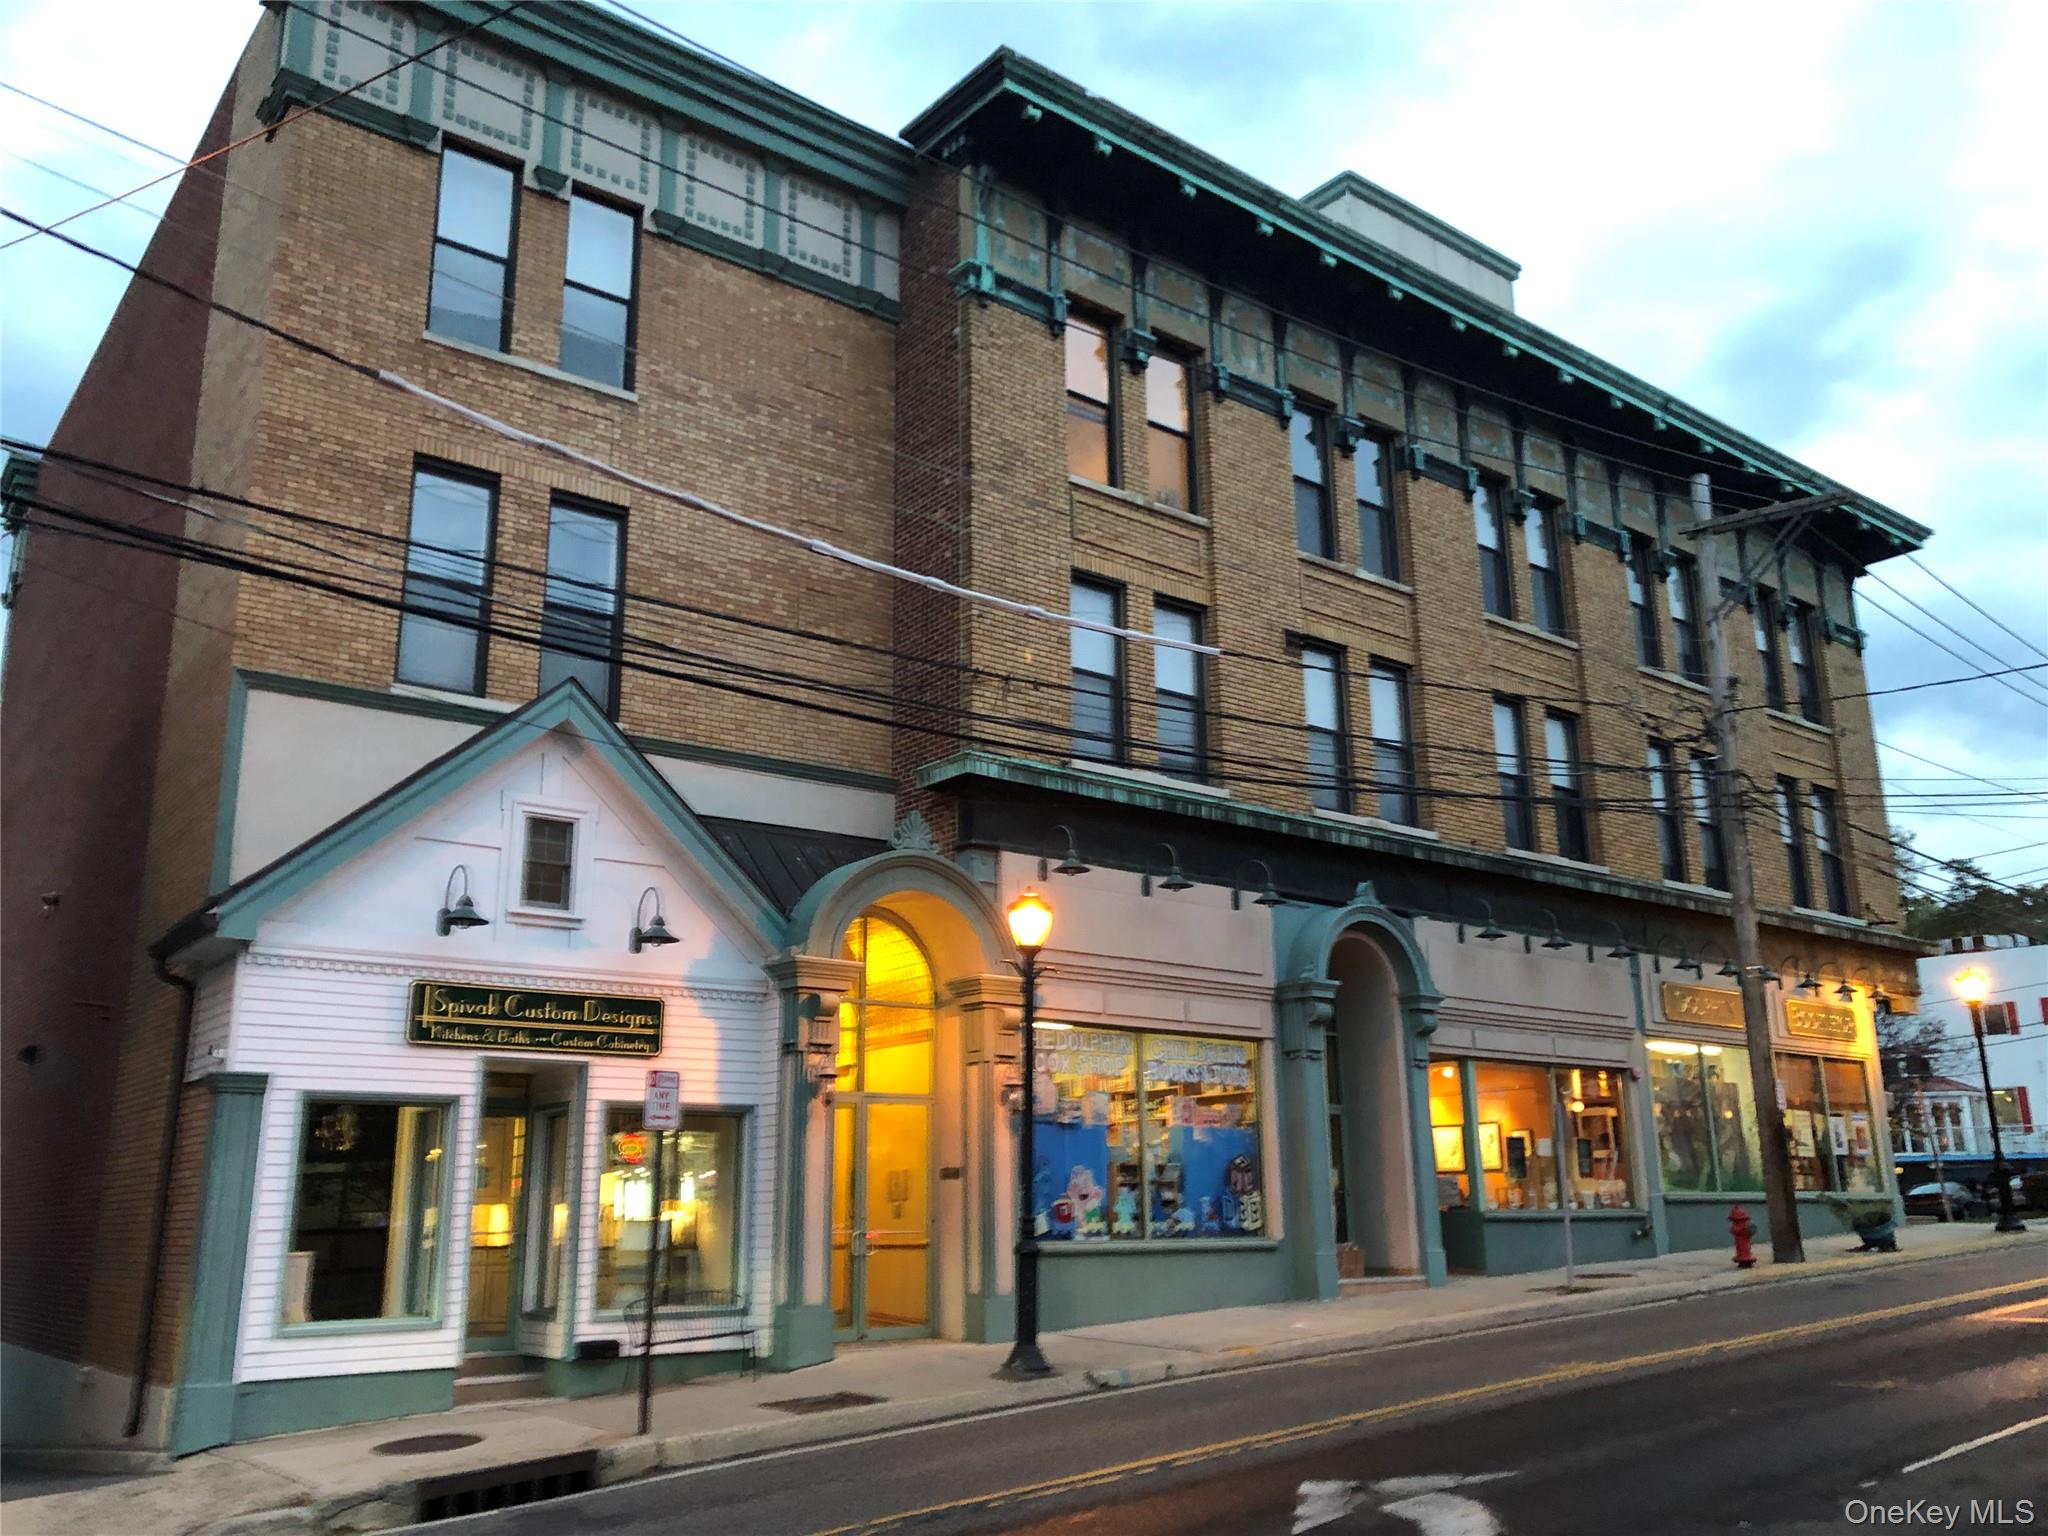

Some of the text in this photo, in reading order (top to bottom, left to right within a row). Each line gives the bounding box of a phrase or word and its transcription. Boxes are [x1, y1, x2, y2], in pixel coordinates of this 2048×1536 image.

[431, 989, 653, 1029] Spivak Custom Designs
[431, 1025, 650, 1053] Kitchens & Baths Custom Cabinetry
[1034, 1052, 1128, 1076] OOK SHOP
